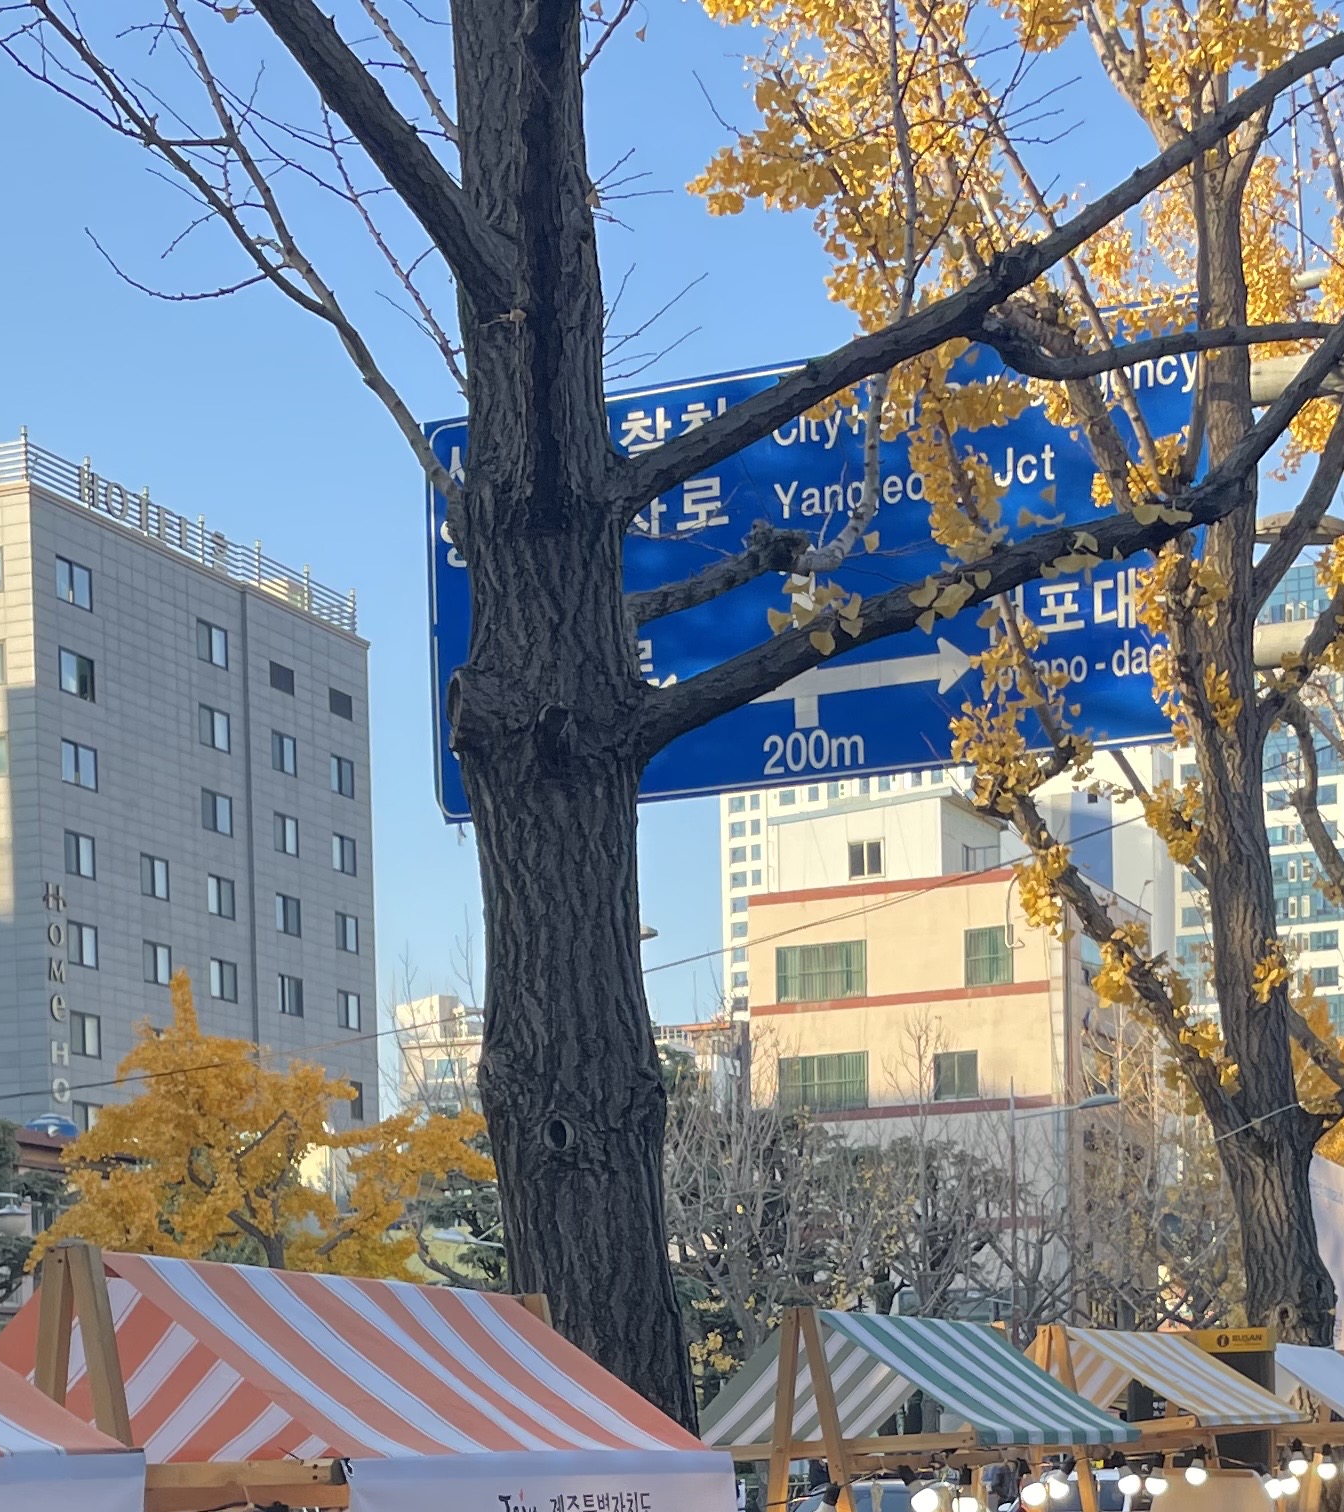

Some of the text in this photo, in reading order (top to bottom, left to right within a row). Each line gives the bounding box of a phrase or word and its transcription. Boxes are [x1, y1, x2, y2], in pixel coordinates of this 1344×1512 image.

[79, 465, 188, 550] HOTEL
[773, 468, 948, 521] Yangeo
[995, 444, 1056, 488] Jct
[763, 729, 866, 776] 200m
[1232, 1333, 1263, 1342] BUSAN
